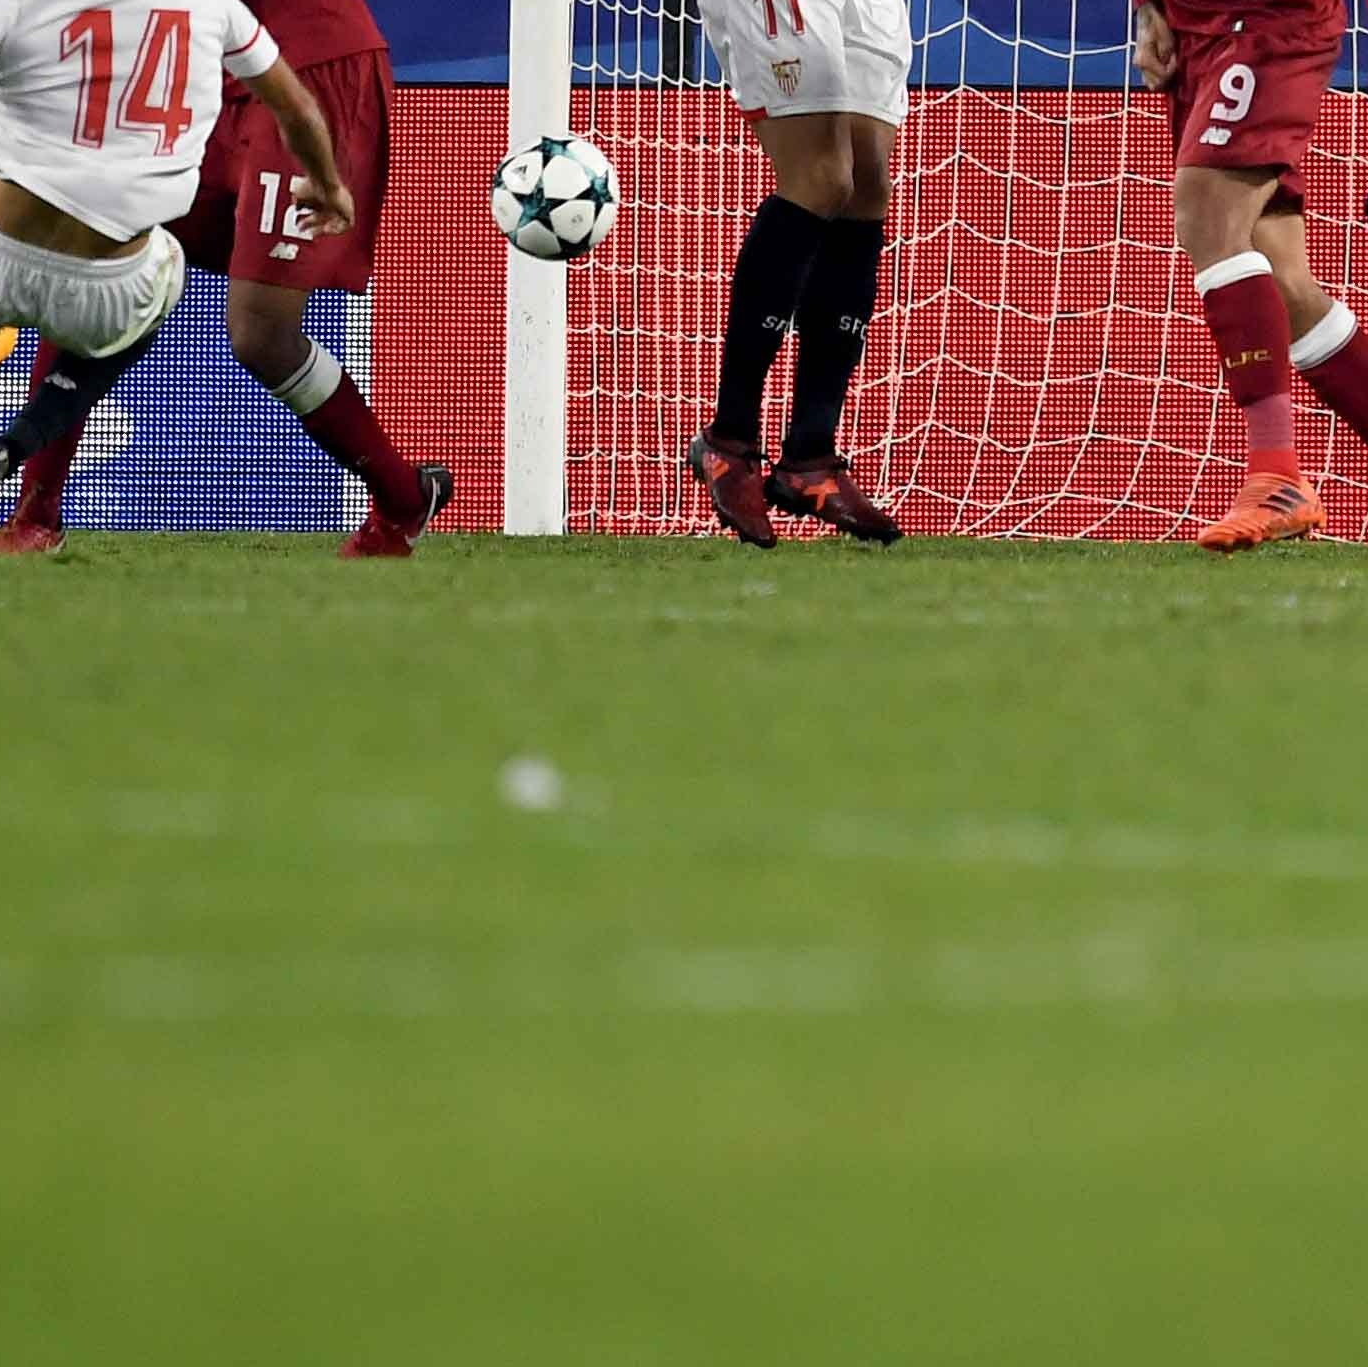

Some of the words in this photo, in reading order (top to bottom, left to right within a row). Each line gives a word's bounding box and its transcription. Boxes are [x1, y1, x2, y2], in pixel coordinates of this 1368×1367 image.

[58, 7, 193, 157] 14
[1209, 63, 1255, 122] 9
[259, 171, 315, 241] 12
